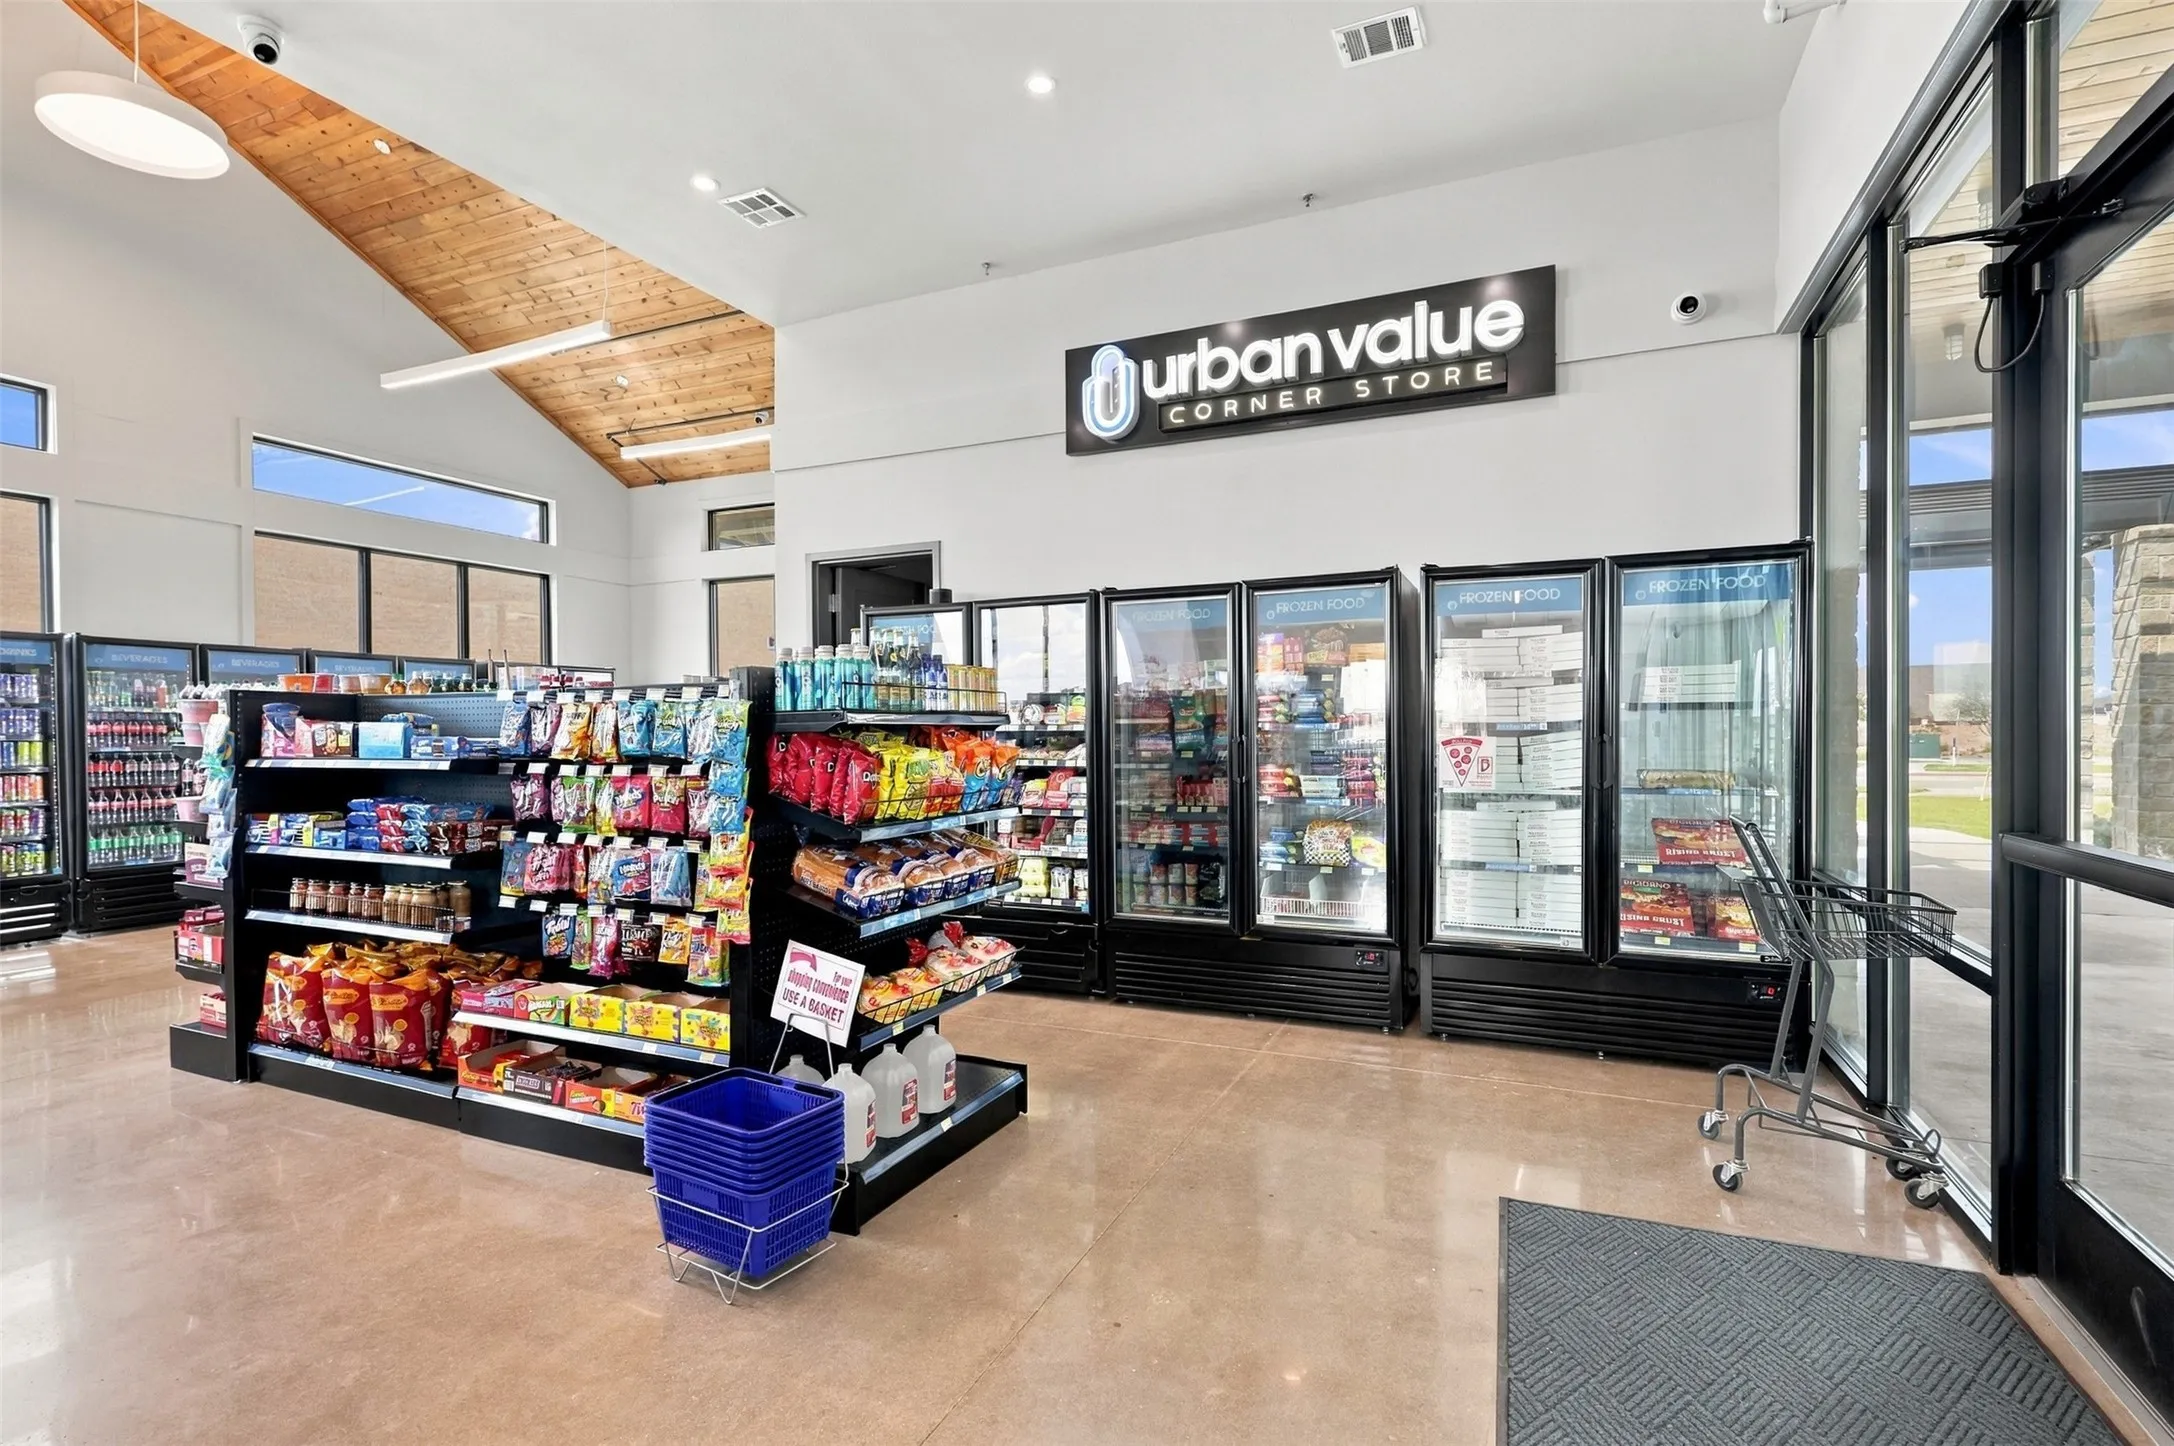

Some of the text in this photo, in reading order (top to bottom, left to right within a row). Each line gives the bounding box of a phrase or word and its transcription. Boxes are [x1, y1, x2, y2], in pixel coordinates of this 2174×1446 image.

[1142, 298, 1525, 400] urban value
[1168, 360, 1495, 425] CORNER STORE
[1459, 587, 1561, 604] FROZEN FOOD
[1648, 574, 1766, 594] FROZEN FOOD
[1177, 607, 1211, 620] FOOD
[1275, 596, 1365, 614] FROZEN FOOD
[812, 978, 850, 1004] convenience
[782, 987, 845, 1023] USE A BASKET
